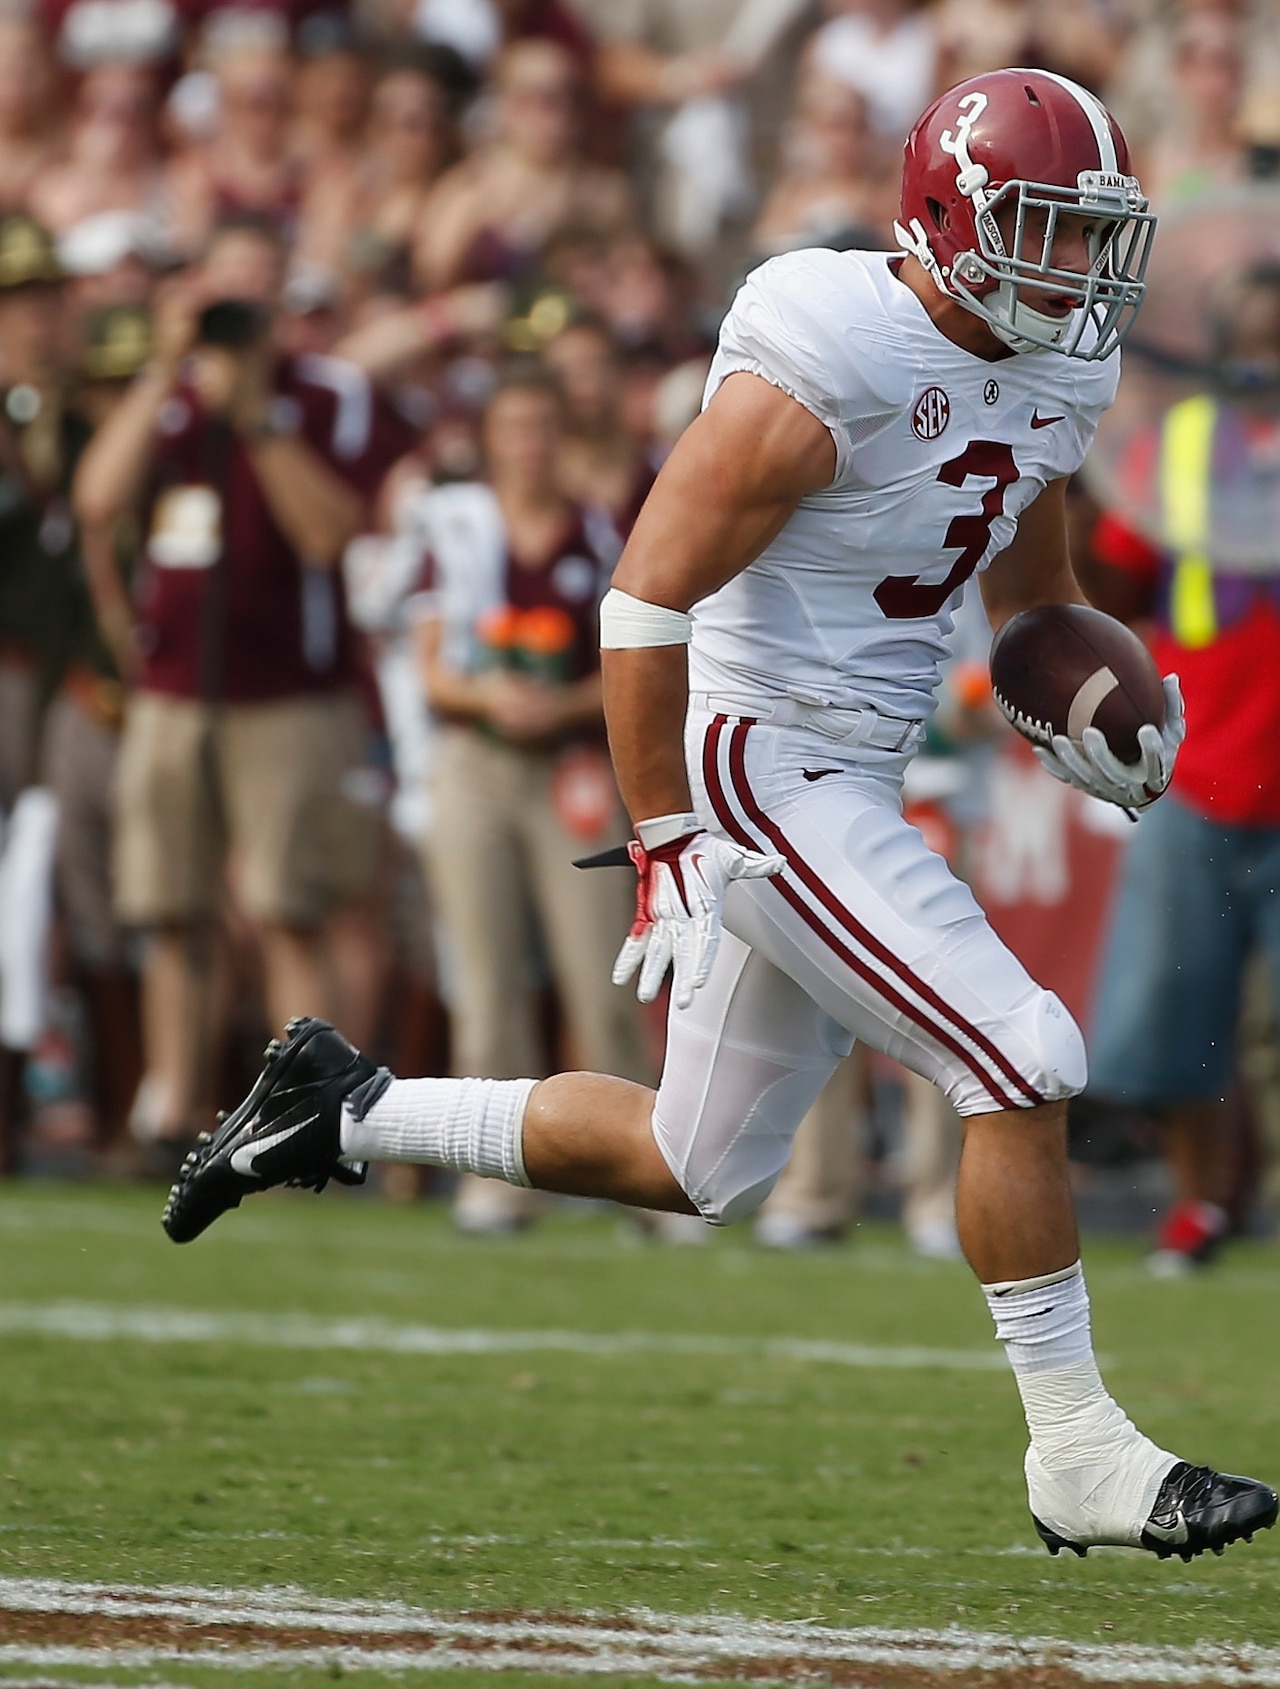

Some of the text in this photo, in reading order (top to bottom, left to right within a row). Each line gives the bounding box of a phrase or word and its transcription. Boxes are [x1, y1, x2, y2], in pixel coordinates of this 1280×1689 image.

[940, 92, 988, 154] 3
[915, 389, 948, 438] SEC
[872, 440, 1020, 618] 3
